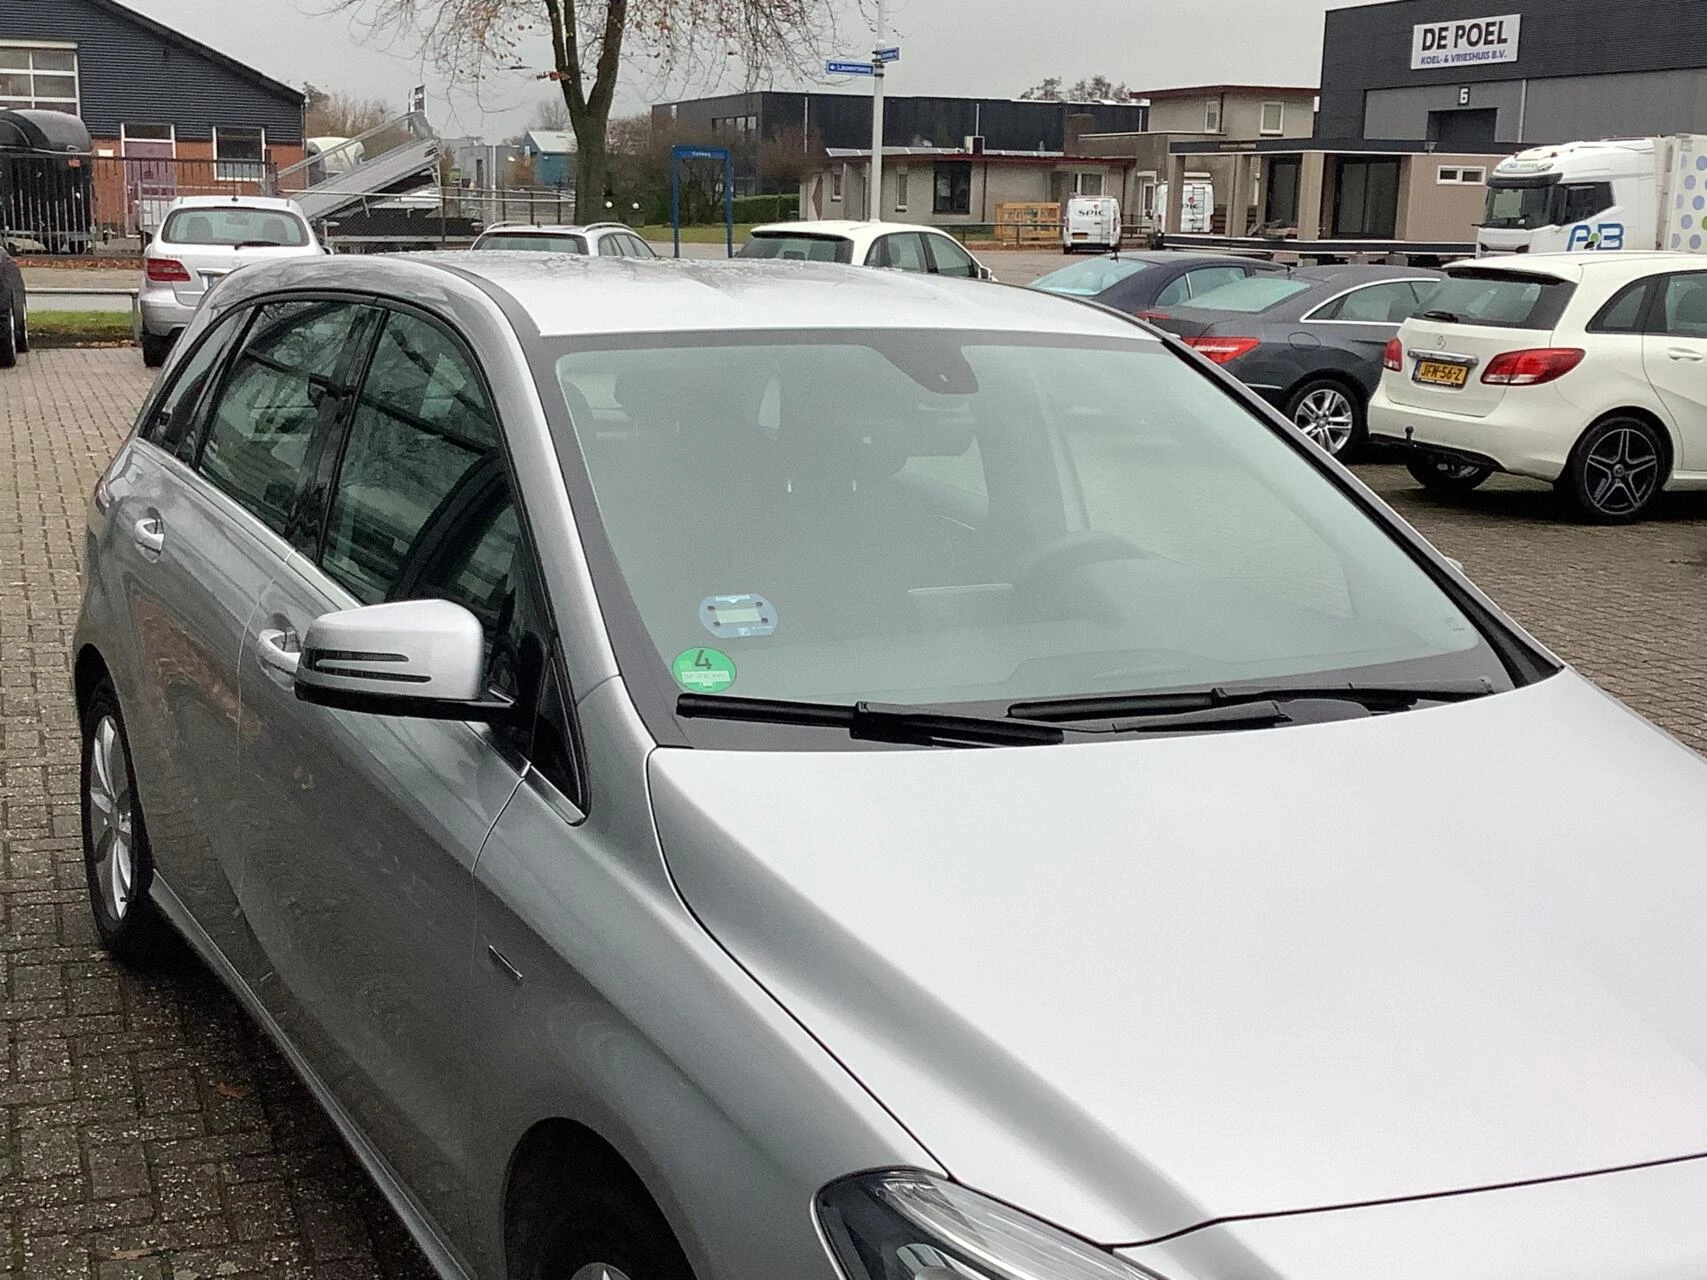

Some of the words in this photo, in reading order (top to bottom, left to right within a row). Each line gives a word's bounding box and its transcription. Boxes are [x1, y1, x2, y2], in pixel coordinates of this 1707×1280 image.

[1422, 27, 1449, 51] DE
[1453, 20, 1508, 48] POEL
[1420, 55, 1442, 65] KOEL-
[1443, 53, 1449, 63] &
[1450, 50, 1490, 63] VRIESHUIS
[1491, 49, 1508, 60] B.V.
[1460, 87, 1469, 104] 6
[1420, 364, 1464, 381] JFN-56-Z
[694, 649, 712, 670] 4
